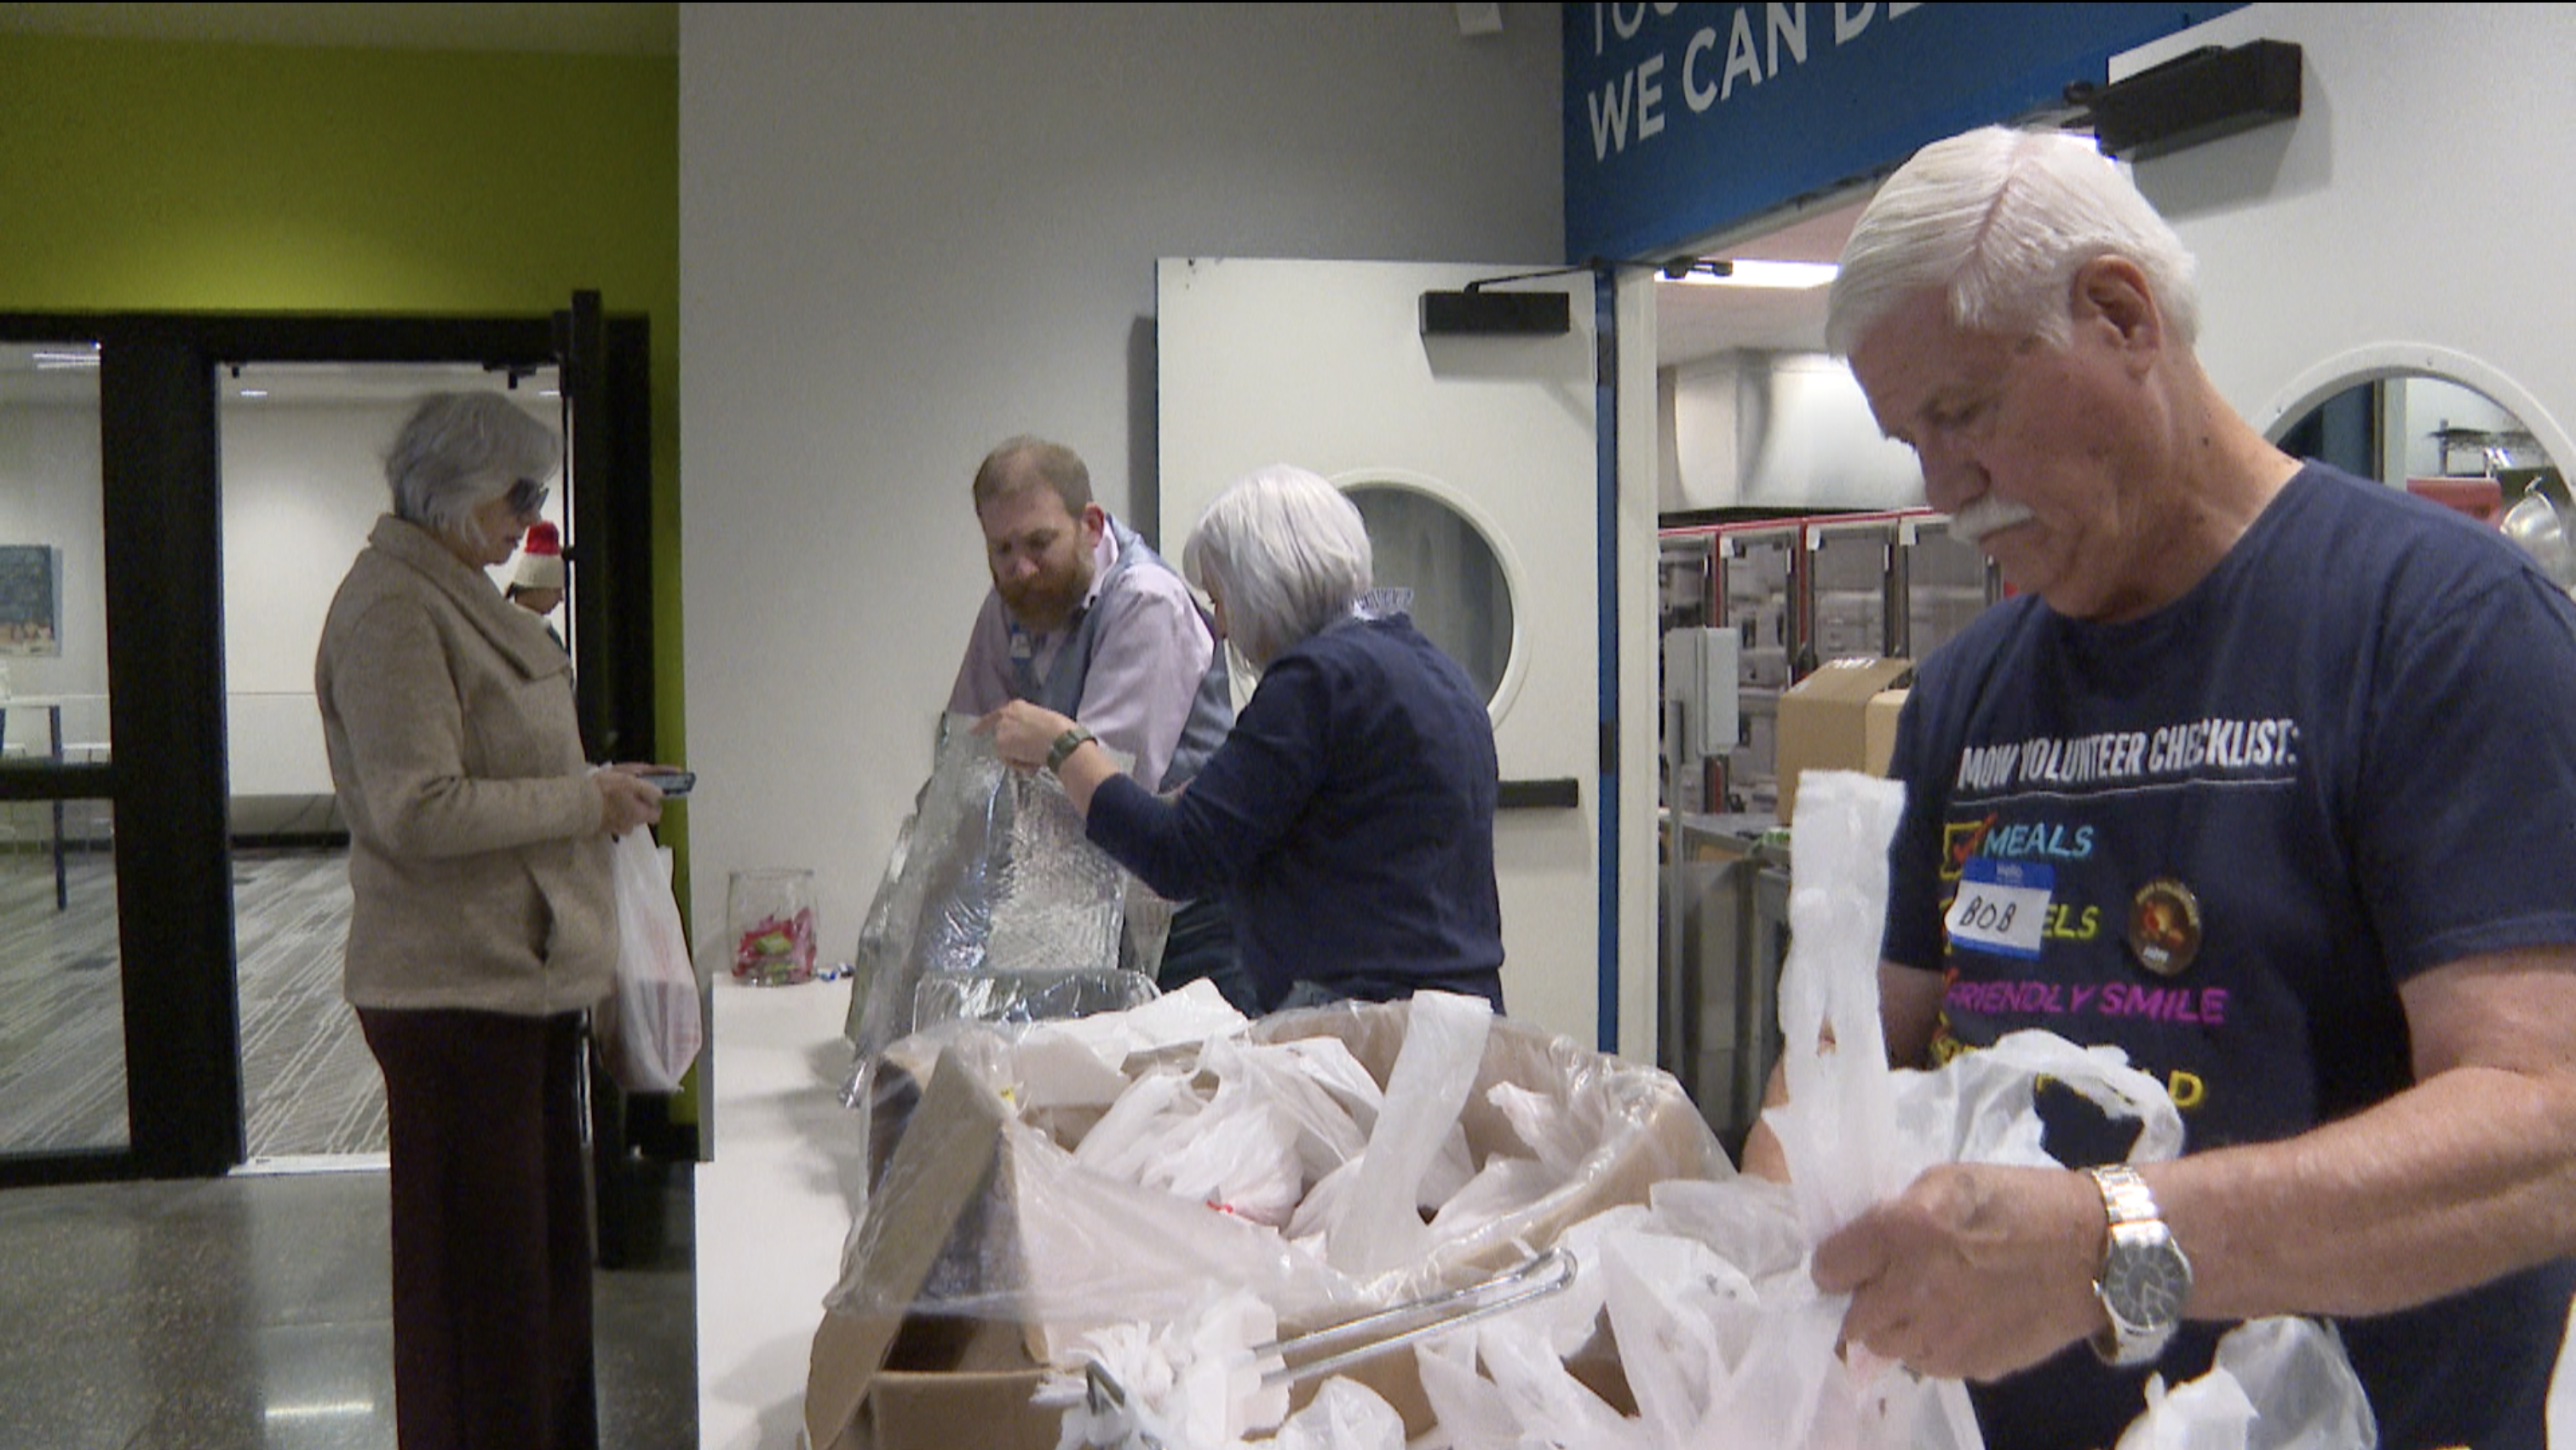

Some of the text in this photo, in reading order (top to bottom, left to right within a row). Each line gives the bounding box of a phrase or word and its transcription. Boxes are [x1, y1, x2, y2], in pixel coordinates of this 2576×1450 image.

[1589, 53, 1665, 162] WE
[1682, 3, 1808, 113] CAN
[1957, 718, 2299, 791] MOW VOLUNTEER CHECKLIST:
[1983, 822, 2095, 857] MEALS
[1960, 895, 2017, 933] BOB
[1945, 980, 2230, 1023] FRIENDLY SMILE
